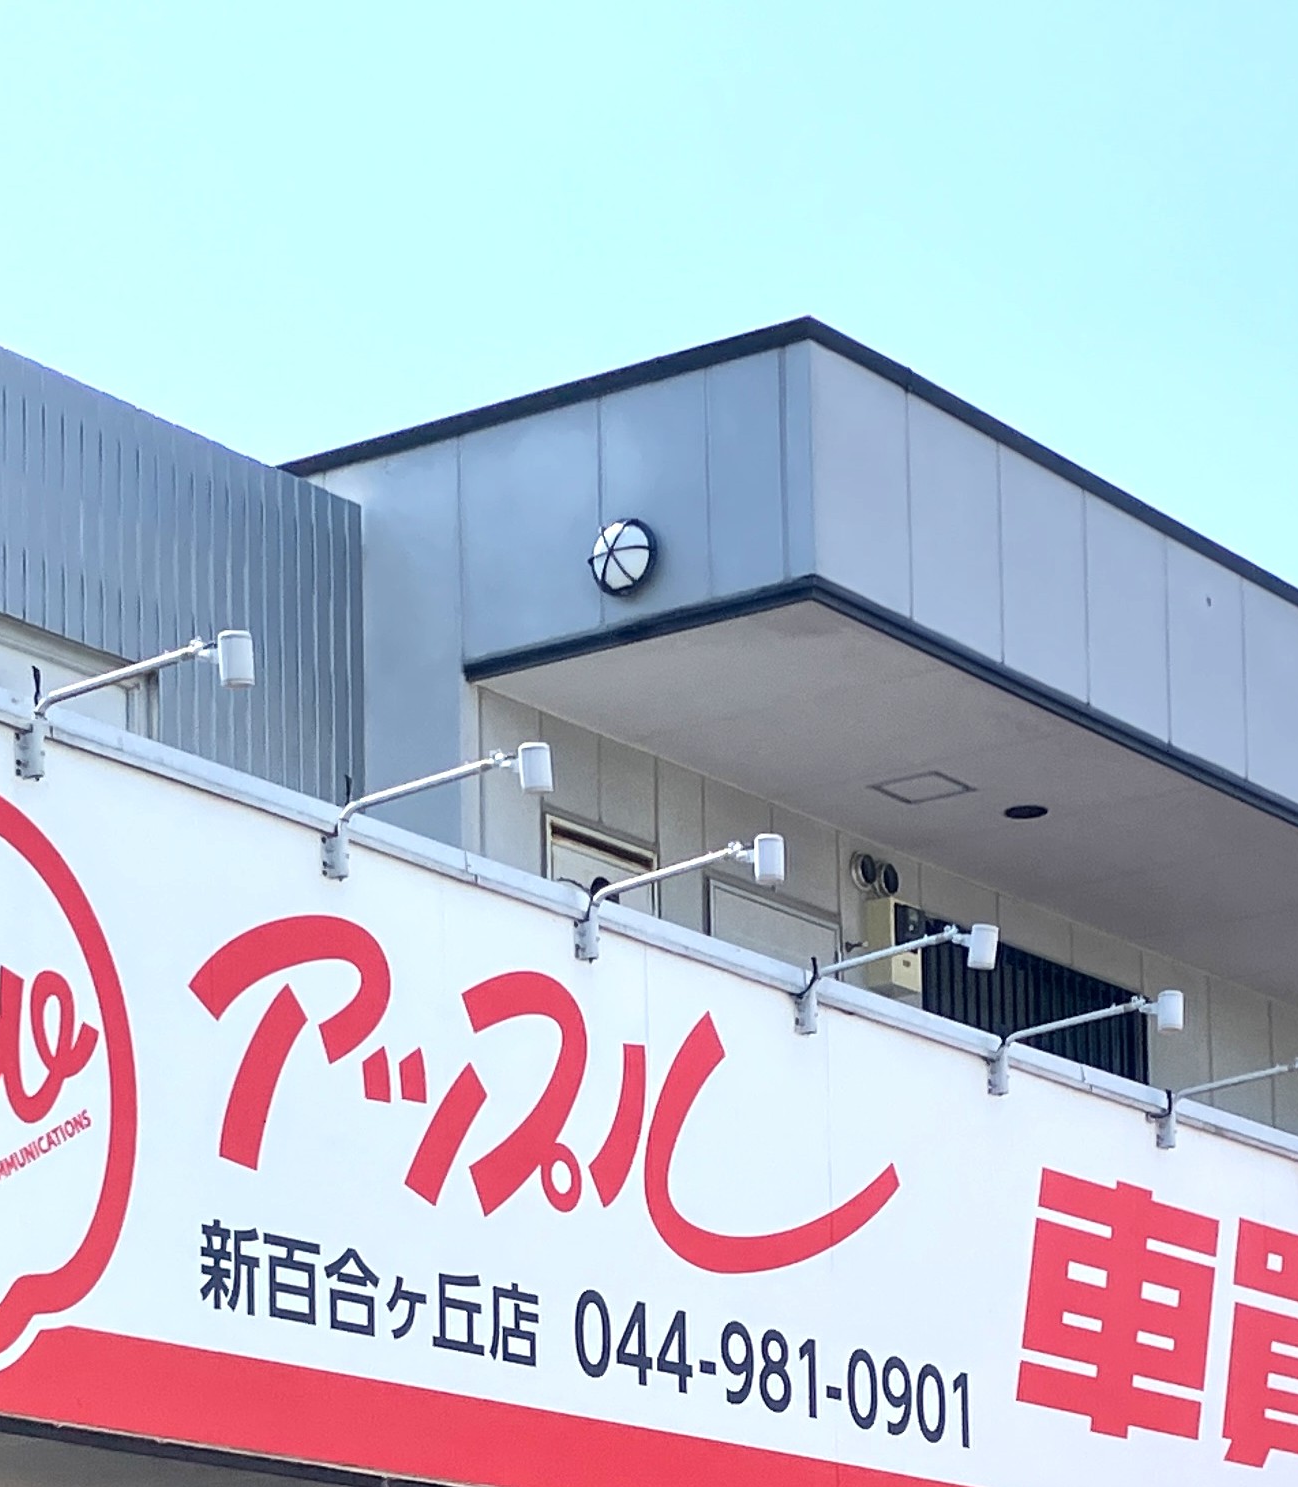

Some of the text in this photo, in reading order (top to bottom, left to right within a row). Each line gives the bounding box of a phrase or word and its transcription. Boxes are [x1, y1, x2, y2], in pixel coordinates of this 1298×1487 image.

[188, 914, 900, 1275] アップル
[574, 1288, 973, 1450] 044-981-0901
